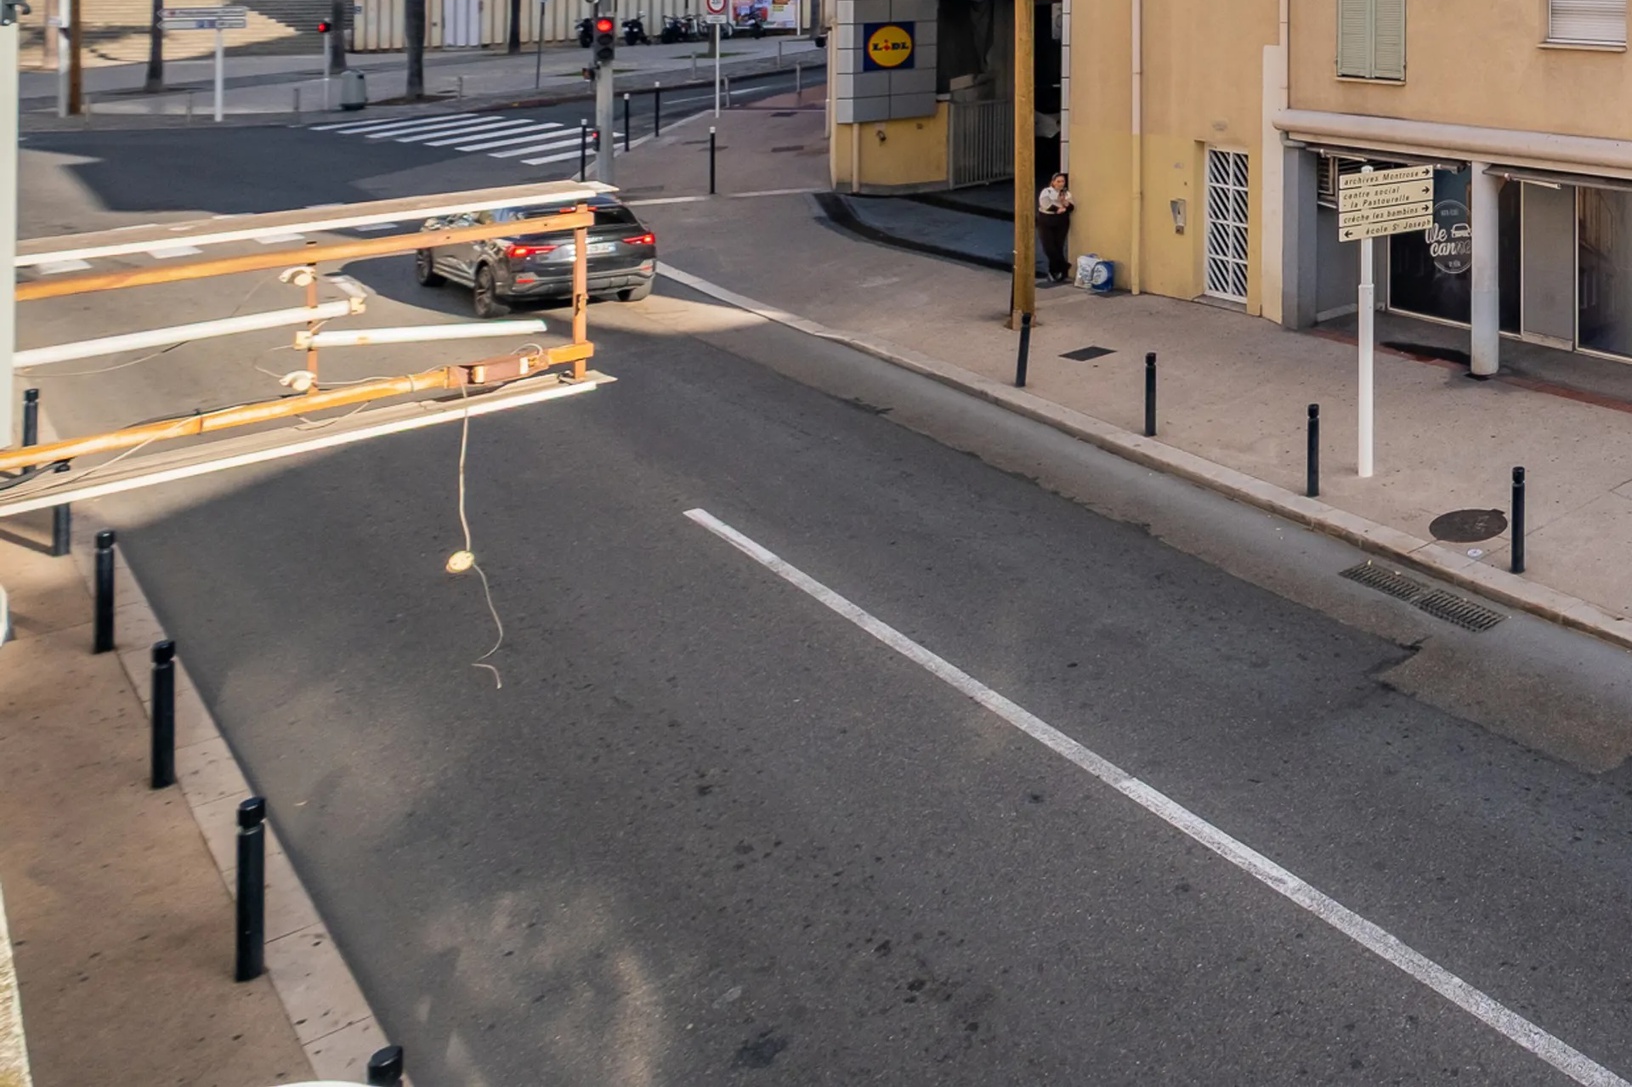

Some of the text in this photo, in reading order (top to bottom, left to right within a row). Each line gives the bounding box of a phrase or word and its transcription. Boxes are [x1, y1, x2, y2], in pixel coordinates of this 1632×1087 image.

[1344, 171, 1419, 186] archives Montrose
[1343, 186, 1400, 200] centre social
[1362, 194, 1410, 207] Pastourelle
[1373, 211, 1384, 219] les
[1387, 207, 1418, 218] bambins
[1366, 225, 1388, 235] école
[1403, 218, 1431, 230] Joseph
[1430, 240, 1472, 257] canne
